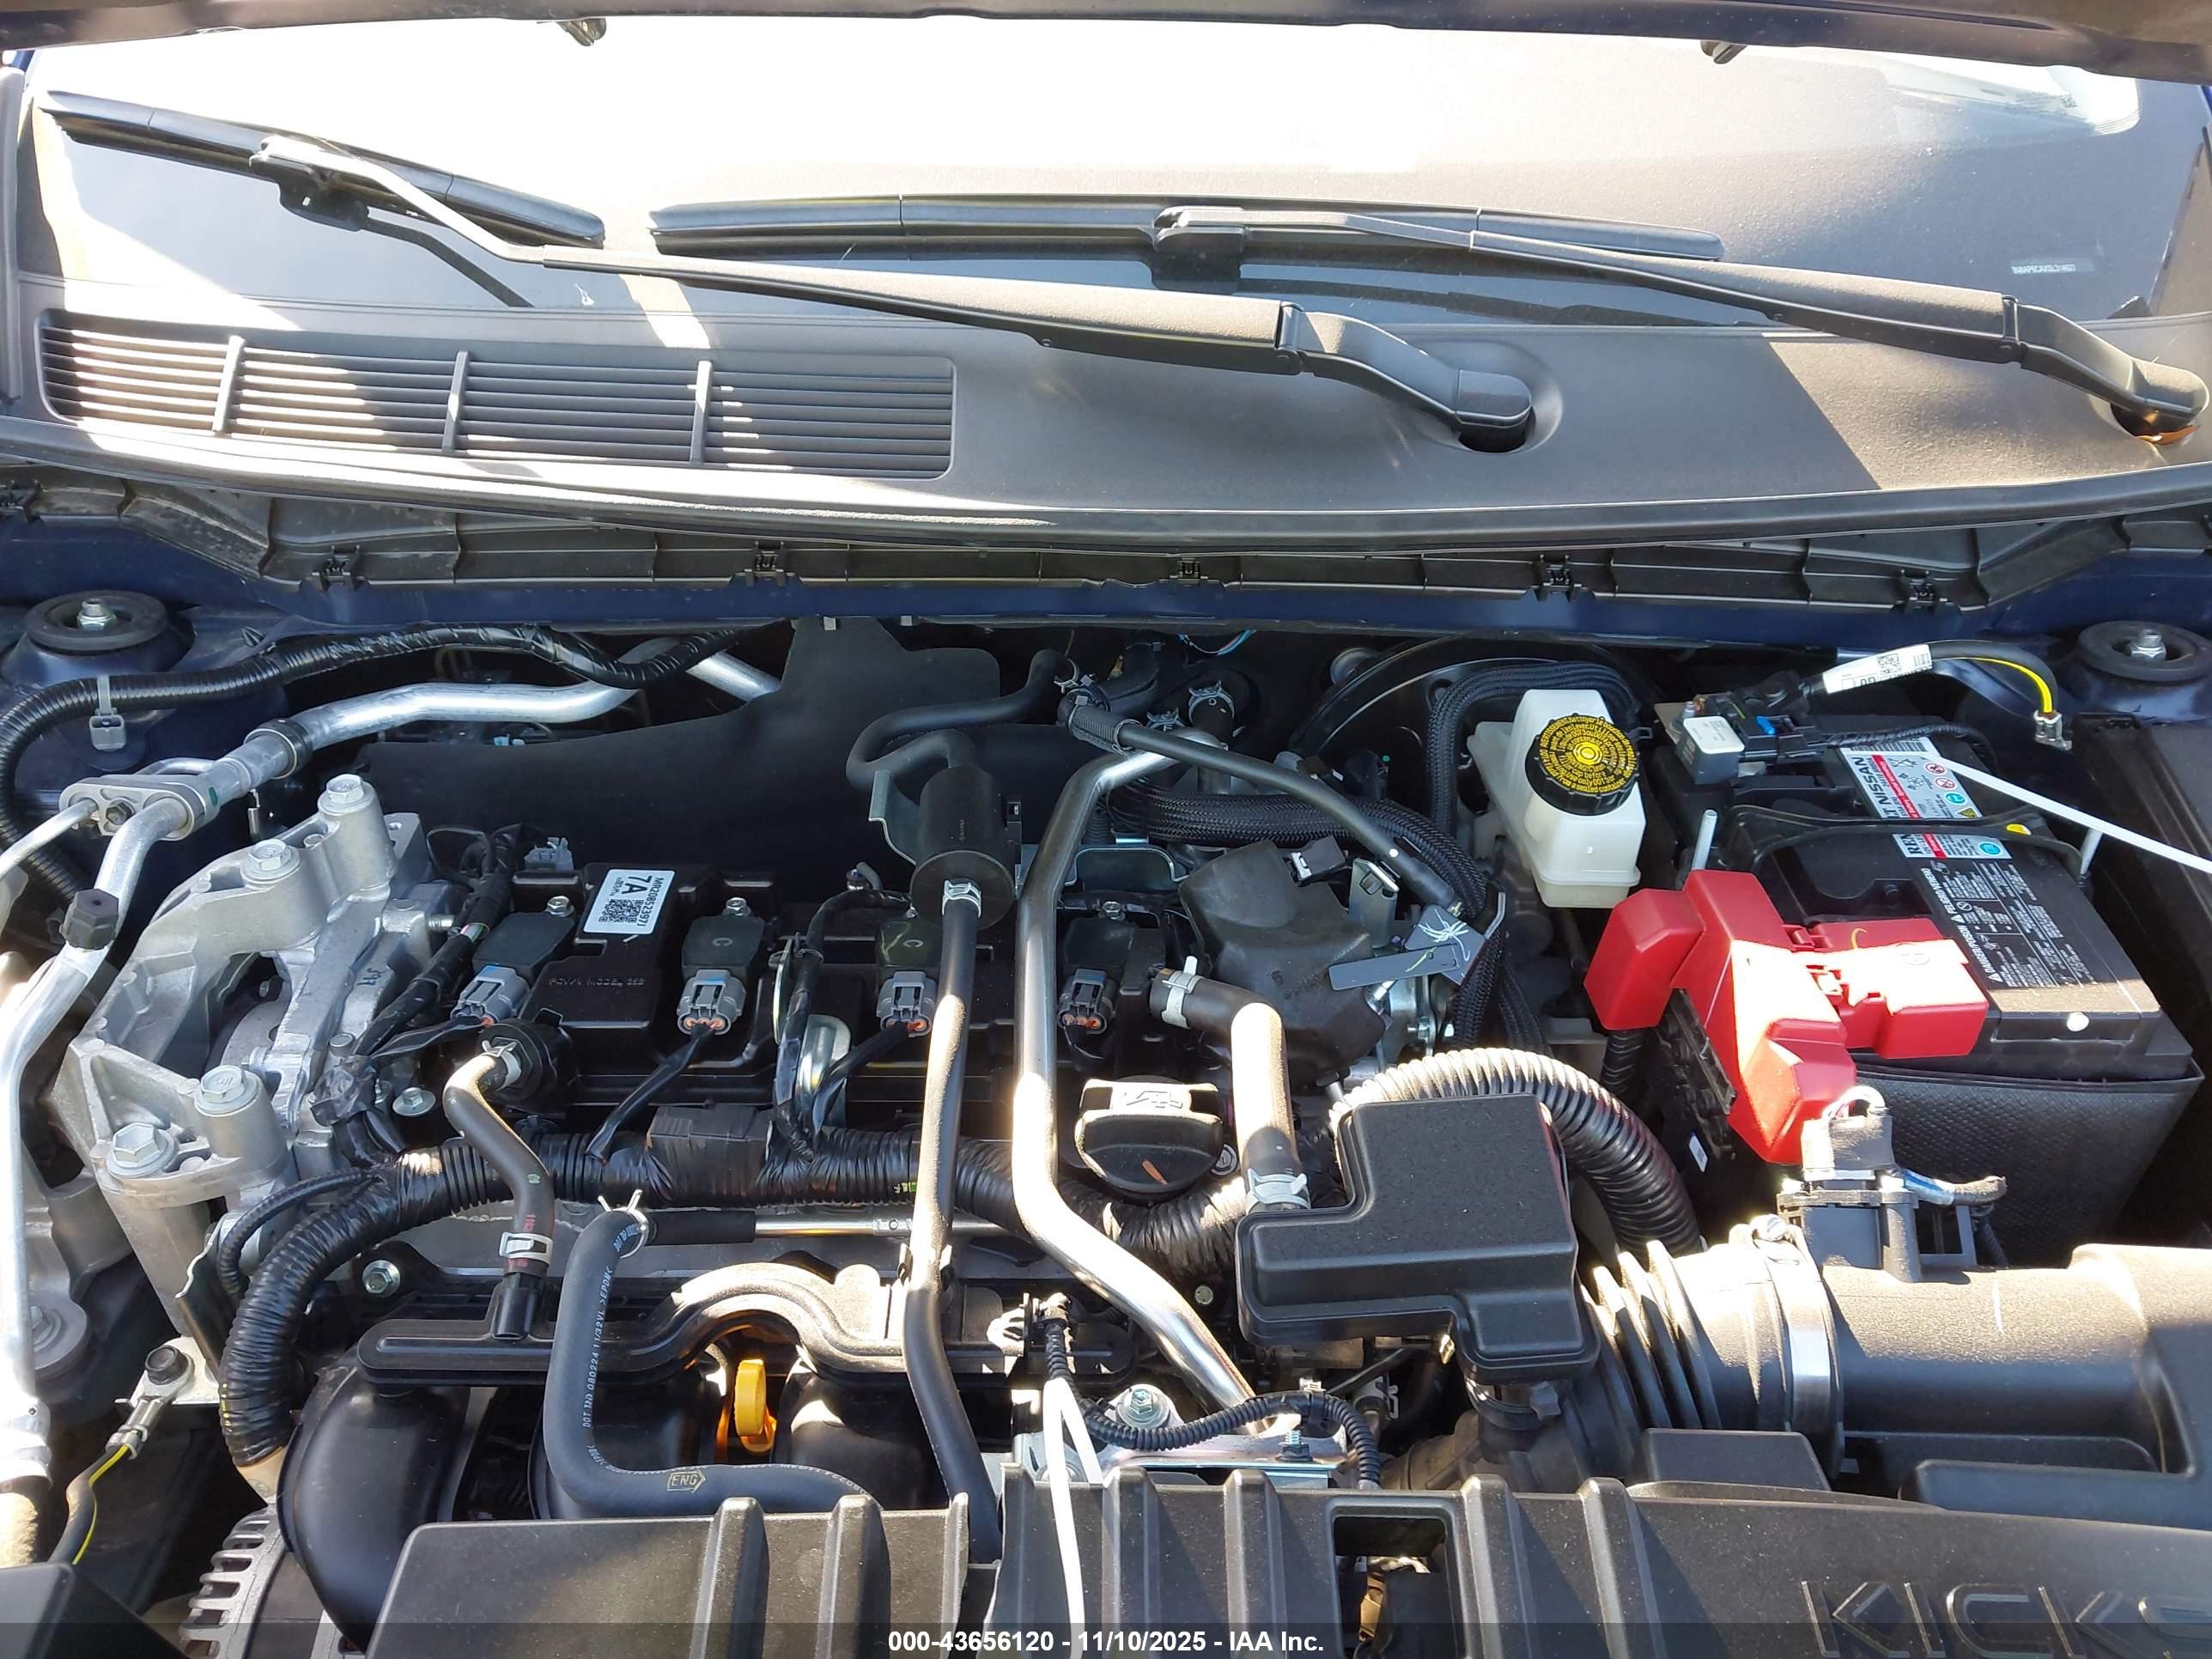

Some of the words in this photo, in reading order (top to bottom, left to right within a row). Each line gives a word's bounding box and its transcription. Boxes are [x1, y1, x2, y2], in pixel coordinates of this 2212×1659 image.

[1851, 757, 1890, 804] NISSAN
[621, 876, 653, 894] 7A
[1920, 867, 1959, 915] PELIGRO/VENENO
[1957, 925, 1996, 974] DANGER/POISON
[672, 1474, 698, 1486] ENG
